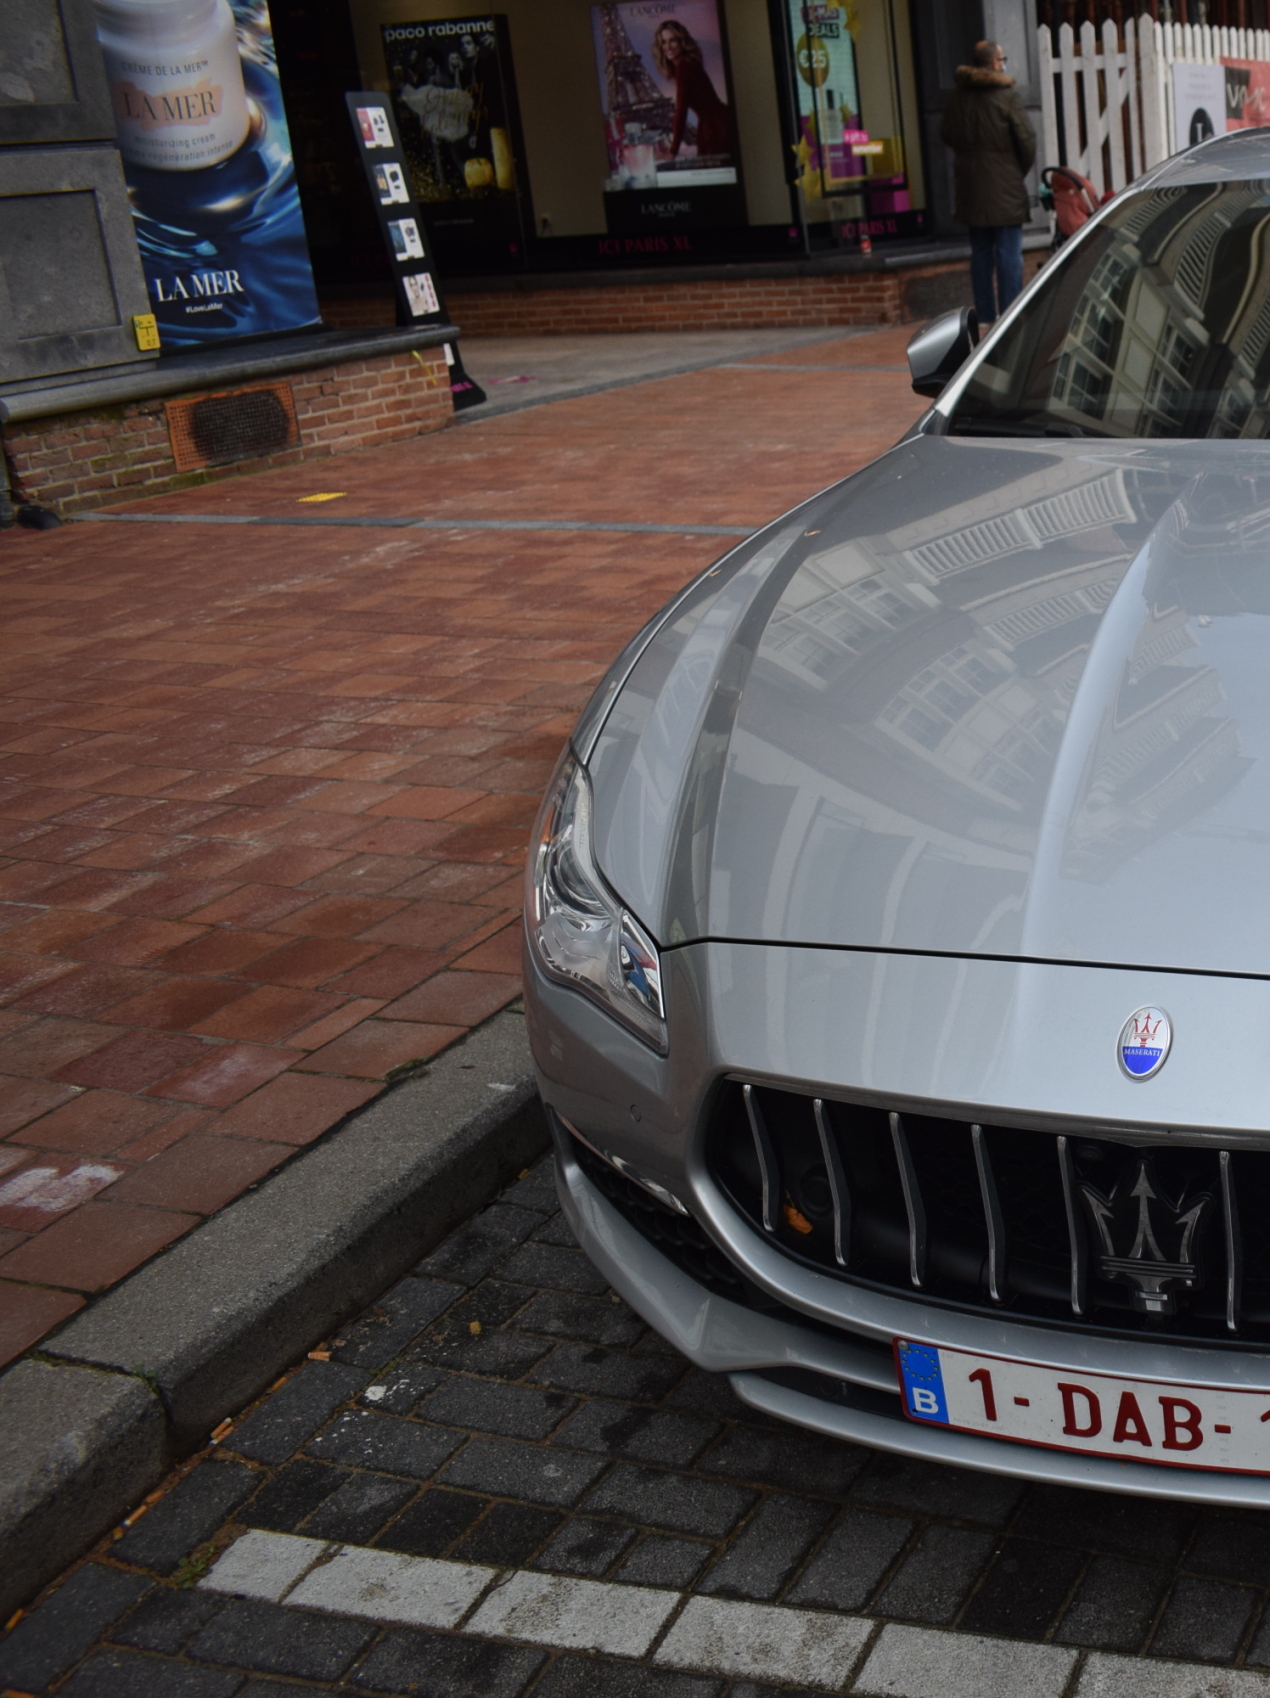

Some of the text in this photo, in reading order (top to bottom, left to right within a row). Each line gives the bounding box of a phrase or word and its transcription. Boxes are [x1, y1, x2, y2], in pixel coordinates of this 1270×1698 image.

[385, 20, 496, 43] paco rabanne
[155, 66, 168, 76] DE
[170, 65, 182, 76] LA
[122, 90, 217, 121] LA MER
[191, 133, 216, 146] cream
[597, 235, 692, 254] ICI PARIS XL
[154, 269, 245, 302] LA MER
[1123, 1048, 1161, 1057] MASERATI
[912, 1387, 939, 1414] B
